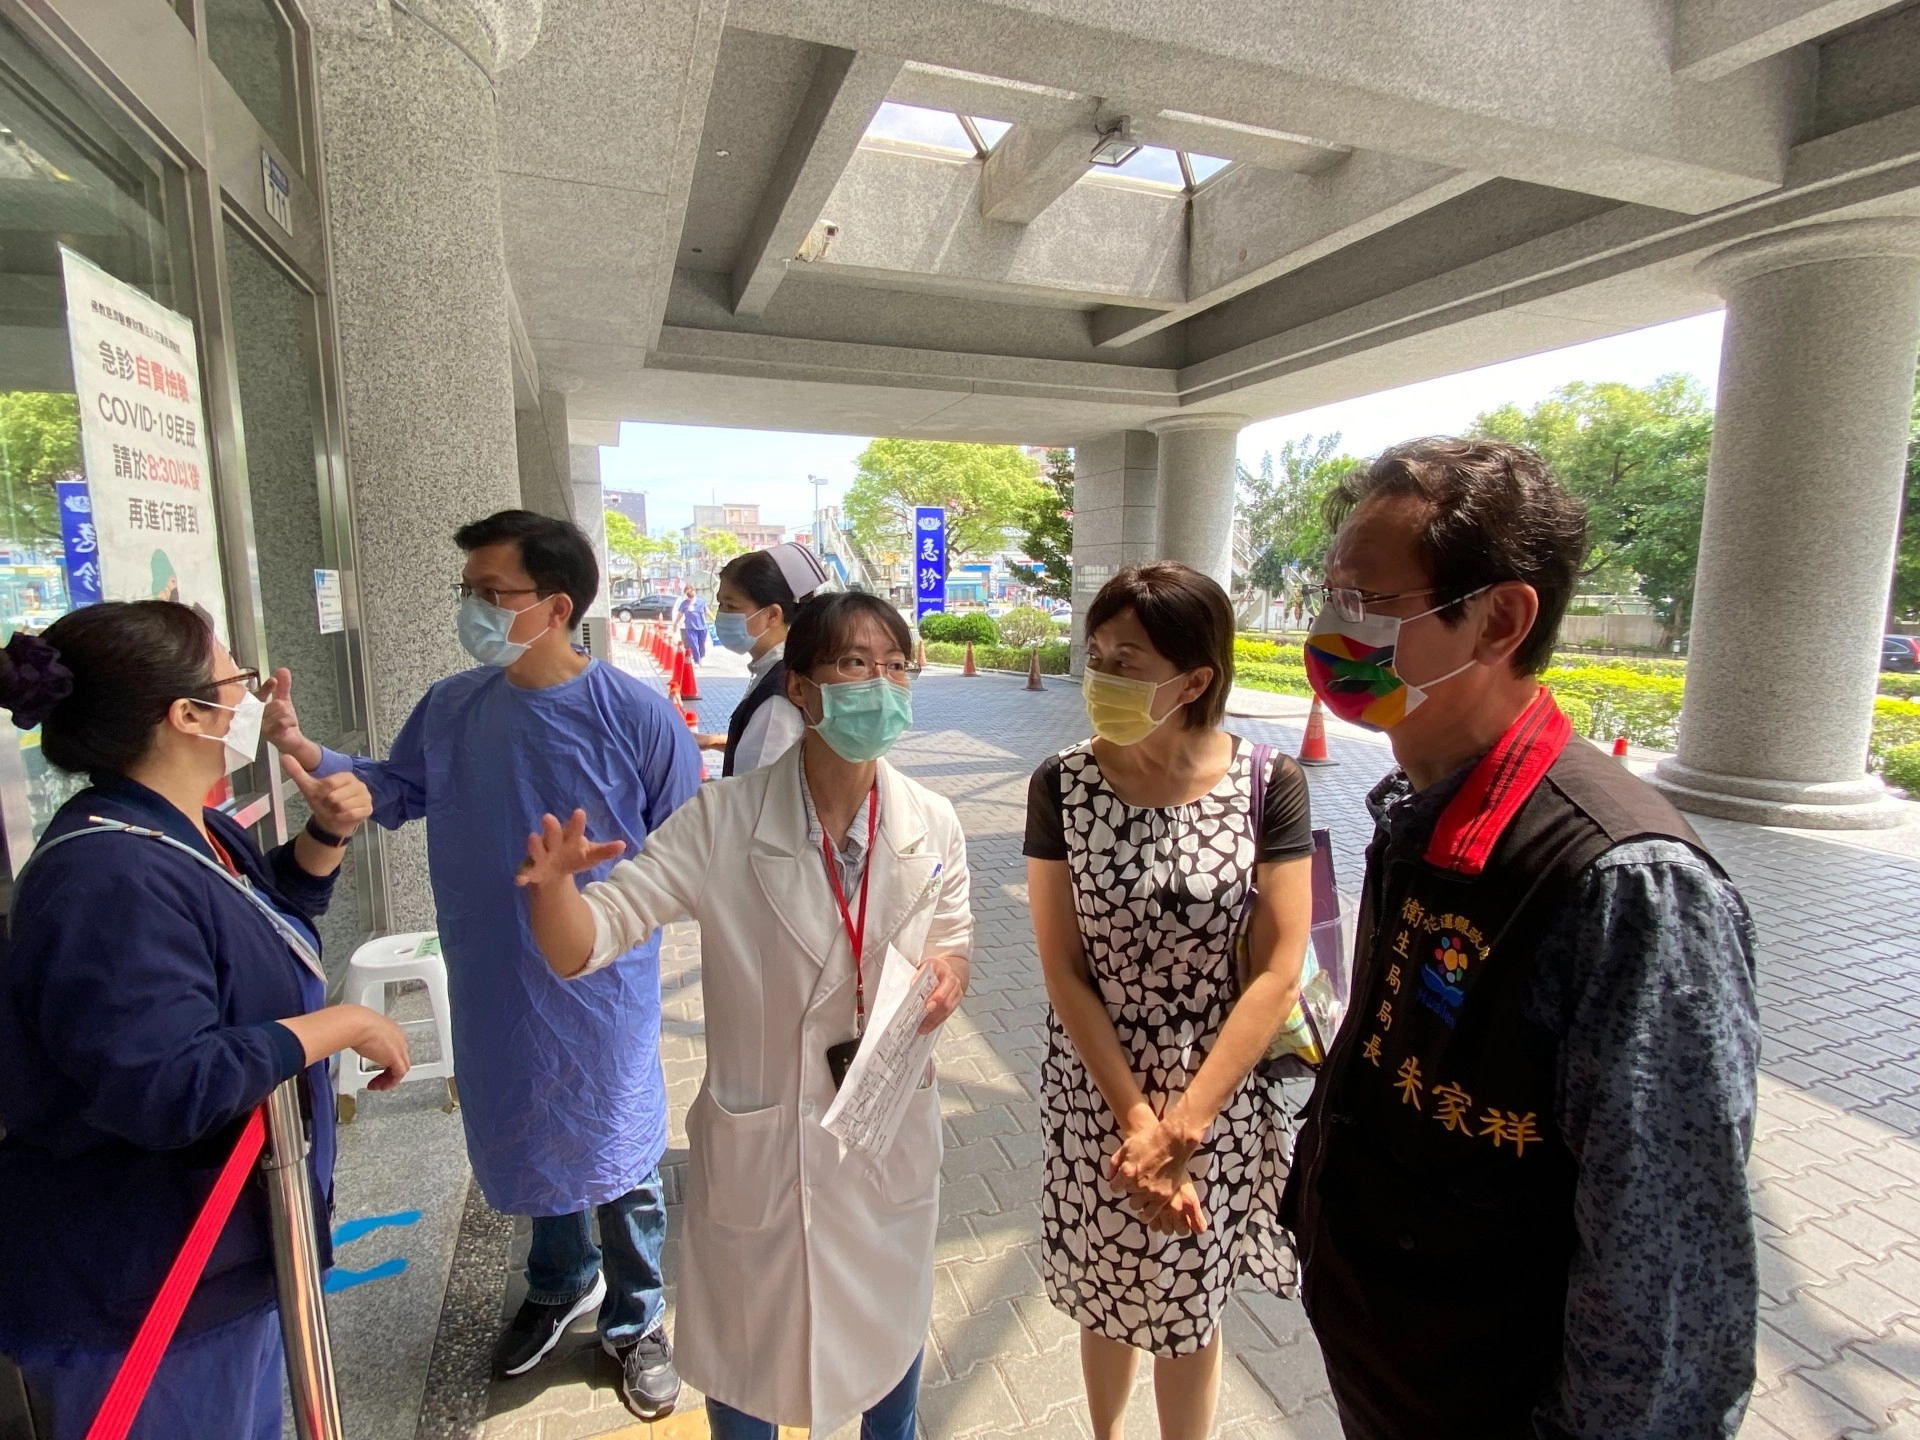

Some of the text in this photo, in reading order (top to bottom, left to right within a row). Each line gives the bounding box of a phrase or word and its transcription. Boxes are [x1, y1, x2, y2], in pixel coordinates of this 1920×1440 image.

[113, 443, 200, 491] 請於8:30以後
[128, 497, 200, 534] 再進行報到
[920, 537, 942, 592] 急診
[1362, 897, 1425, 1068] 衛生局局長
[1393, 1056, 1544, 1159] 朱家祥
